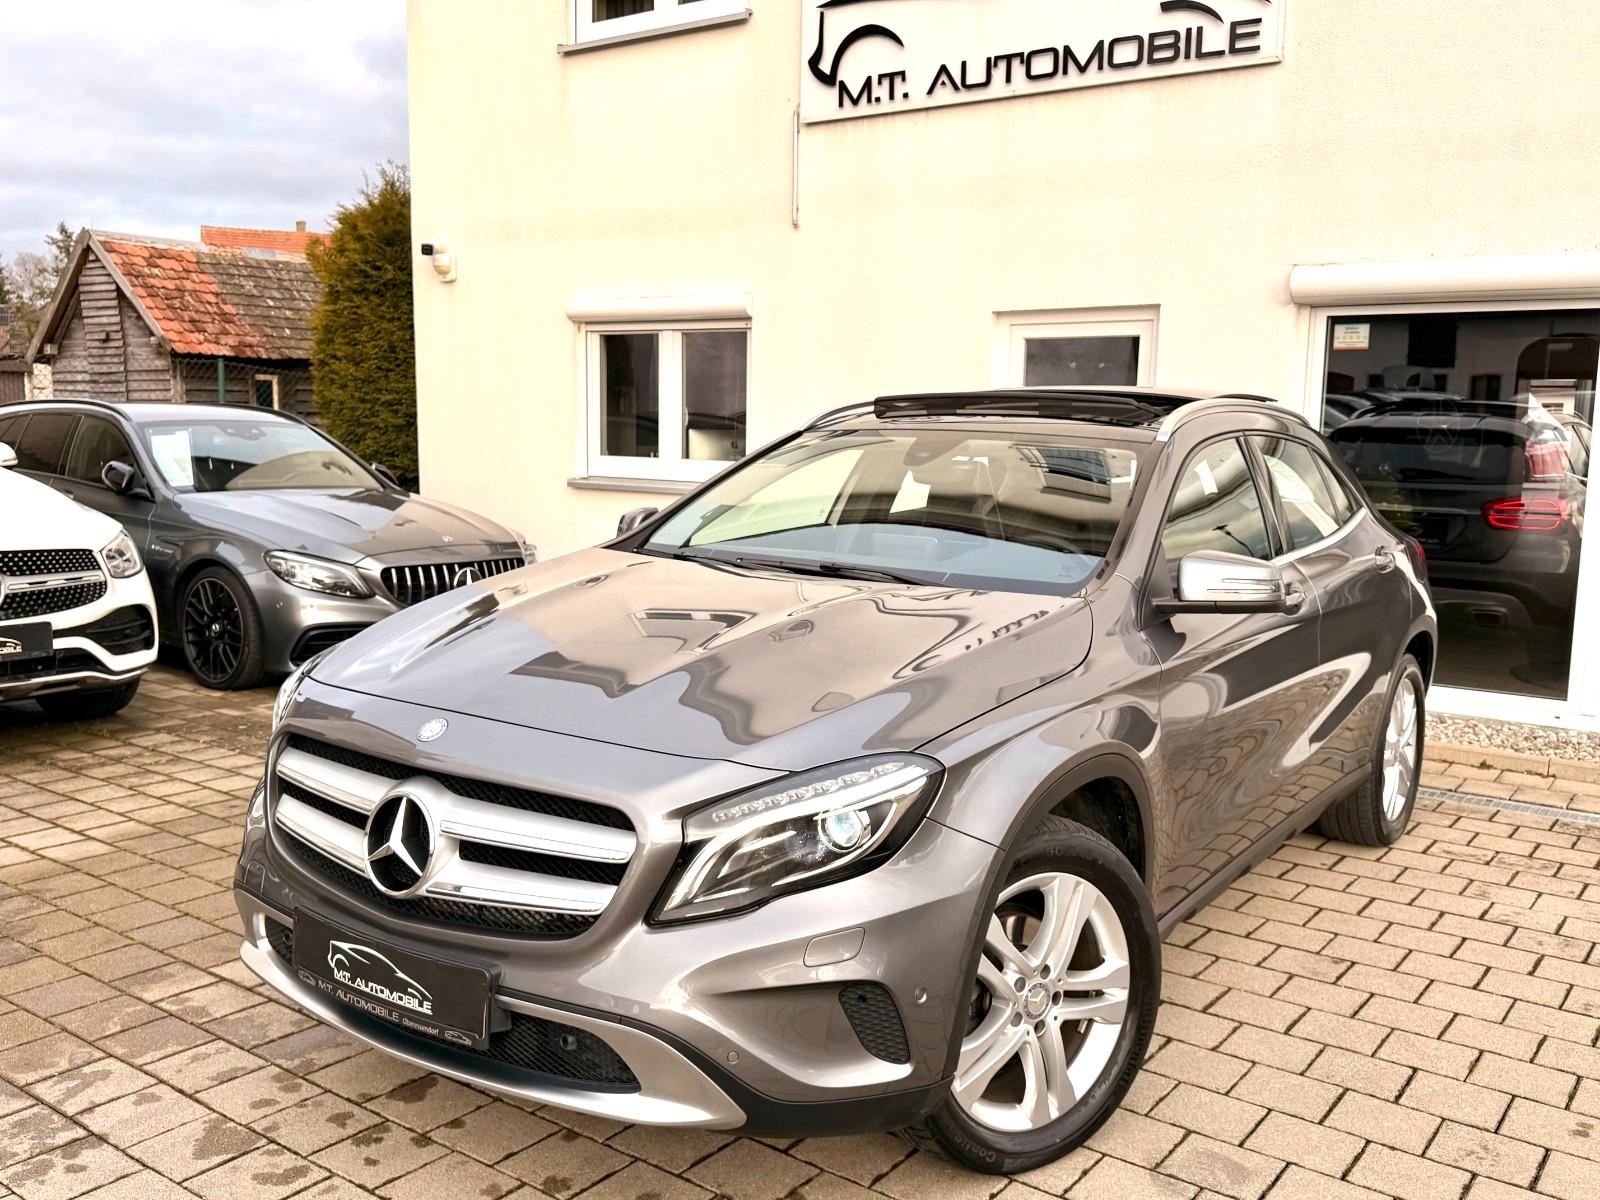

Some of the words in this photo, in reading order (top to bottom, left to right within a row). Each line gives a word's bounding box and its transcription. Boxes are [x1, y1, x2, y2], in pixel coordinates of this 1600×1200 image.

[838, 70, 909, 108] M.T.
[926, 17, 1262, 96] AUTOMOBILE
[318, 980, 334, 995] M.T.
[336, 989, 400, 1022] AUTOMOBILE
[334, 969, 352, 983] M.T.
[355, 978, 433, 1014] AUTOMOBILE
